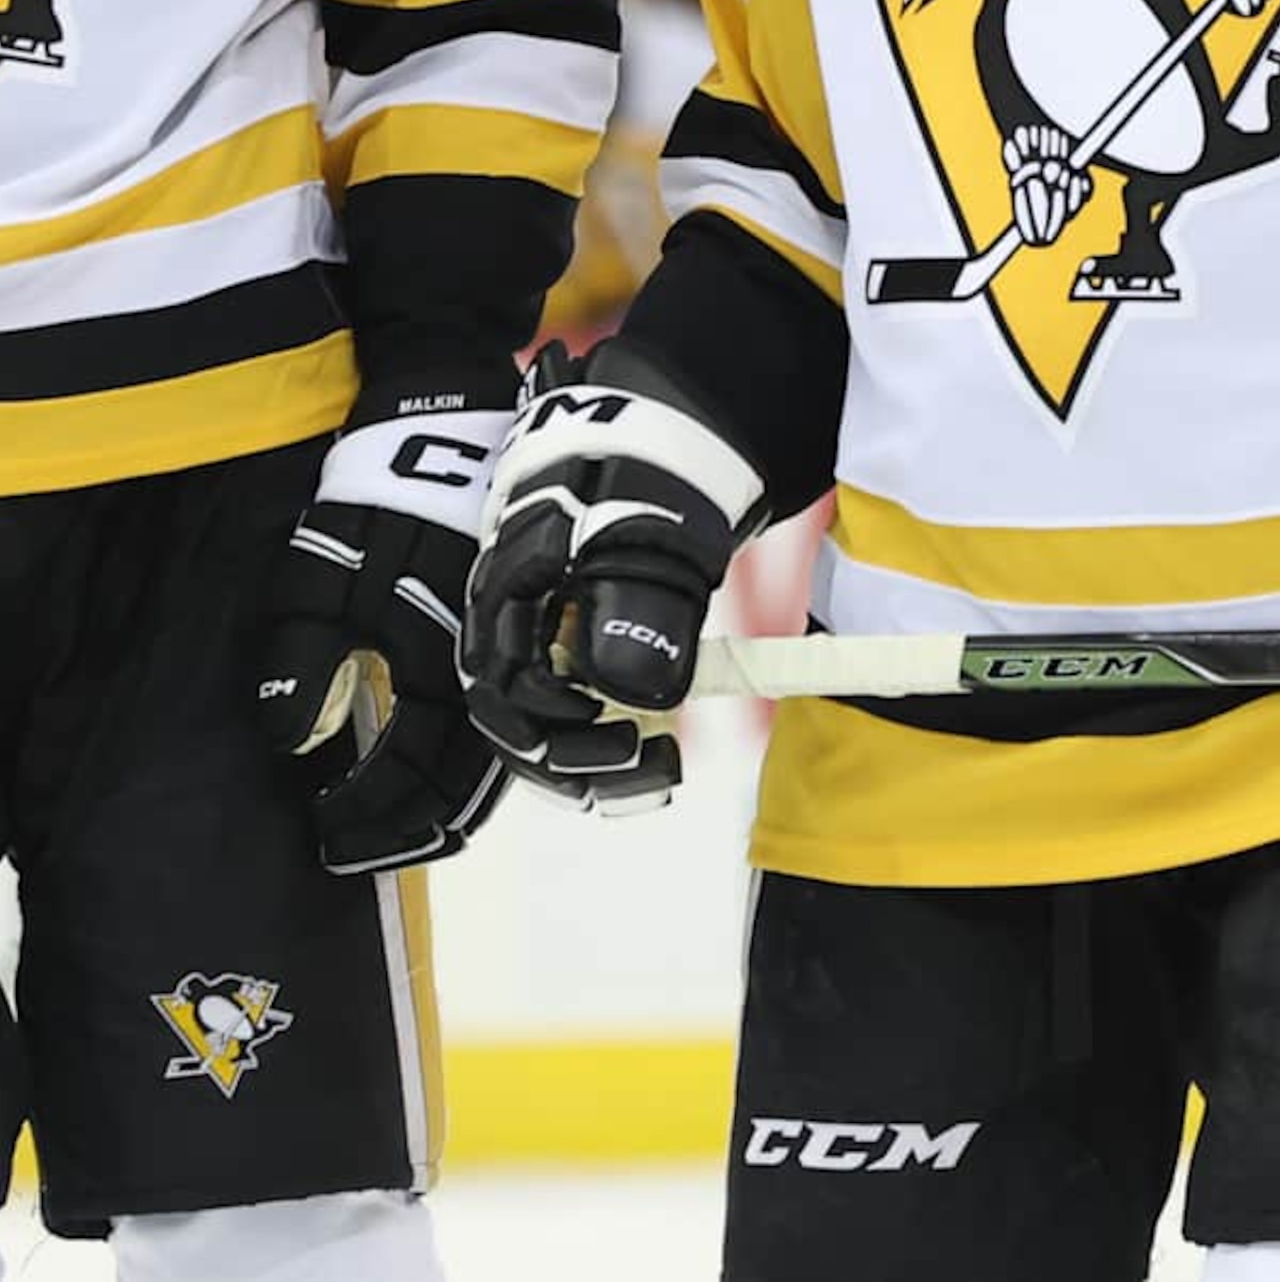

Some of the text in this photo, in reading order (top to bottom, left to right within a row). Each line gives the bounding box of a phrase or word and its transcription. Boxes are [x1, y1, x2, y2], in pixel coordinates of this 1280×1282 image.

[398, 393, 465, 414] MALKIN
[603, 620, 681, 662] CCM
[985, 653, 1150, 682] CCM
[742, 1117, 982, 1173] CCM
